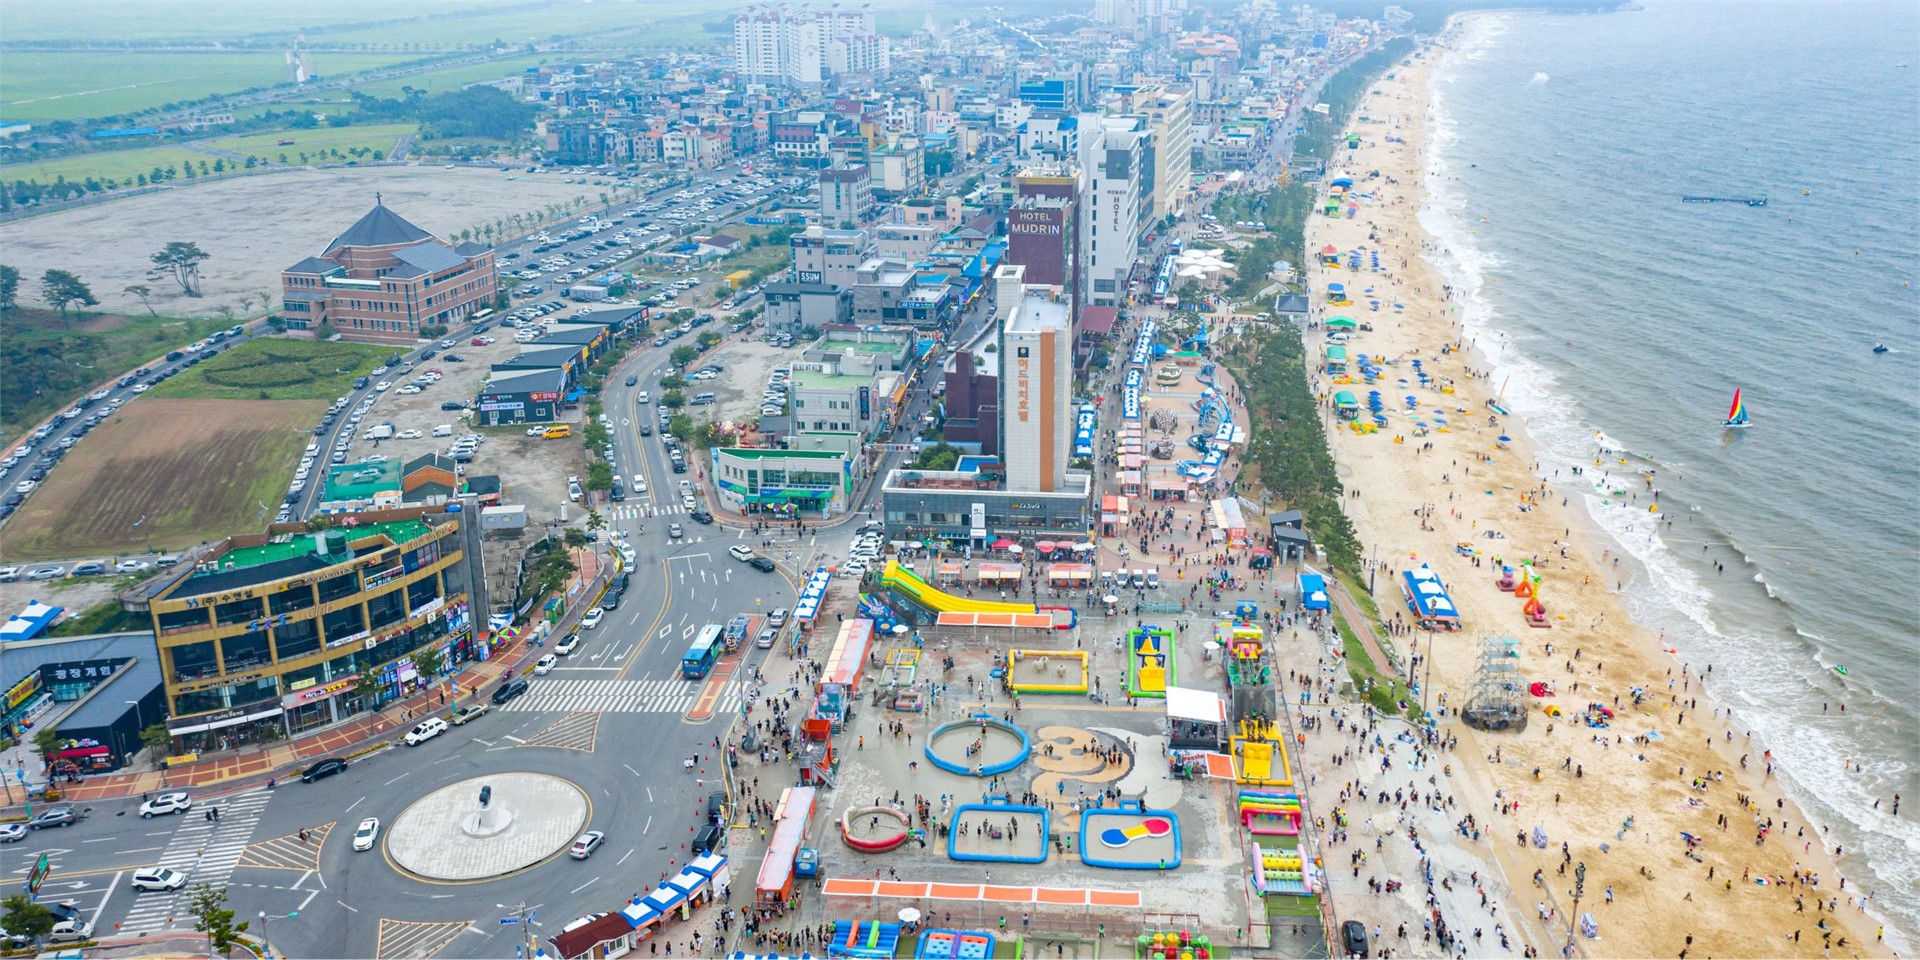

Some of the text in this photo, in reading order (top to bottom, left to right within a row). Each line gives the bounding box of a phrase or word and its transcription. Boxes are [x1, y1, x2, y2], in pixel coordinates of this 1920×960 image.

[1019, 212, 1052, 221] HOTEL
[1011, 223, 1060, 235] MUDRIN
[801, 271, 820, 281] SSUM
[1017, 358, 1030, 422] 머드비치호텔
[202, 596, 218, 606] (주)
[306, 601, 335, 619] Club
